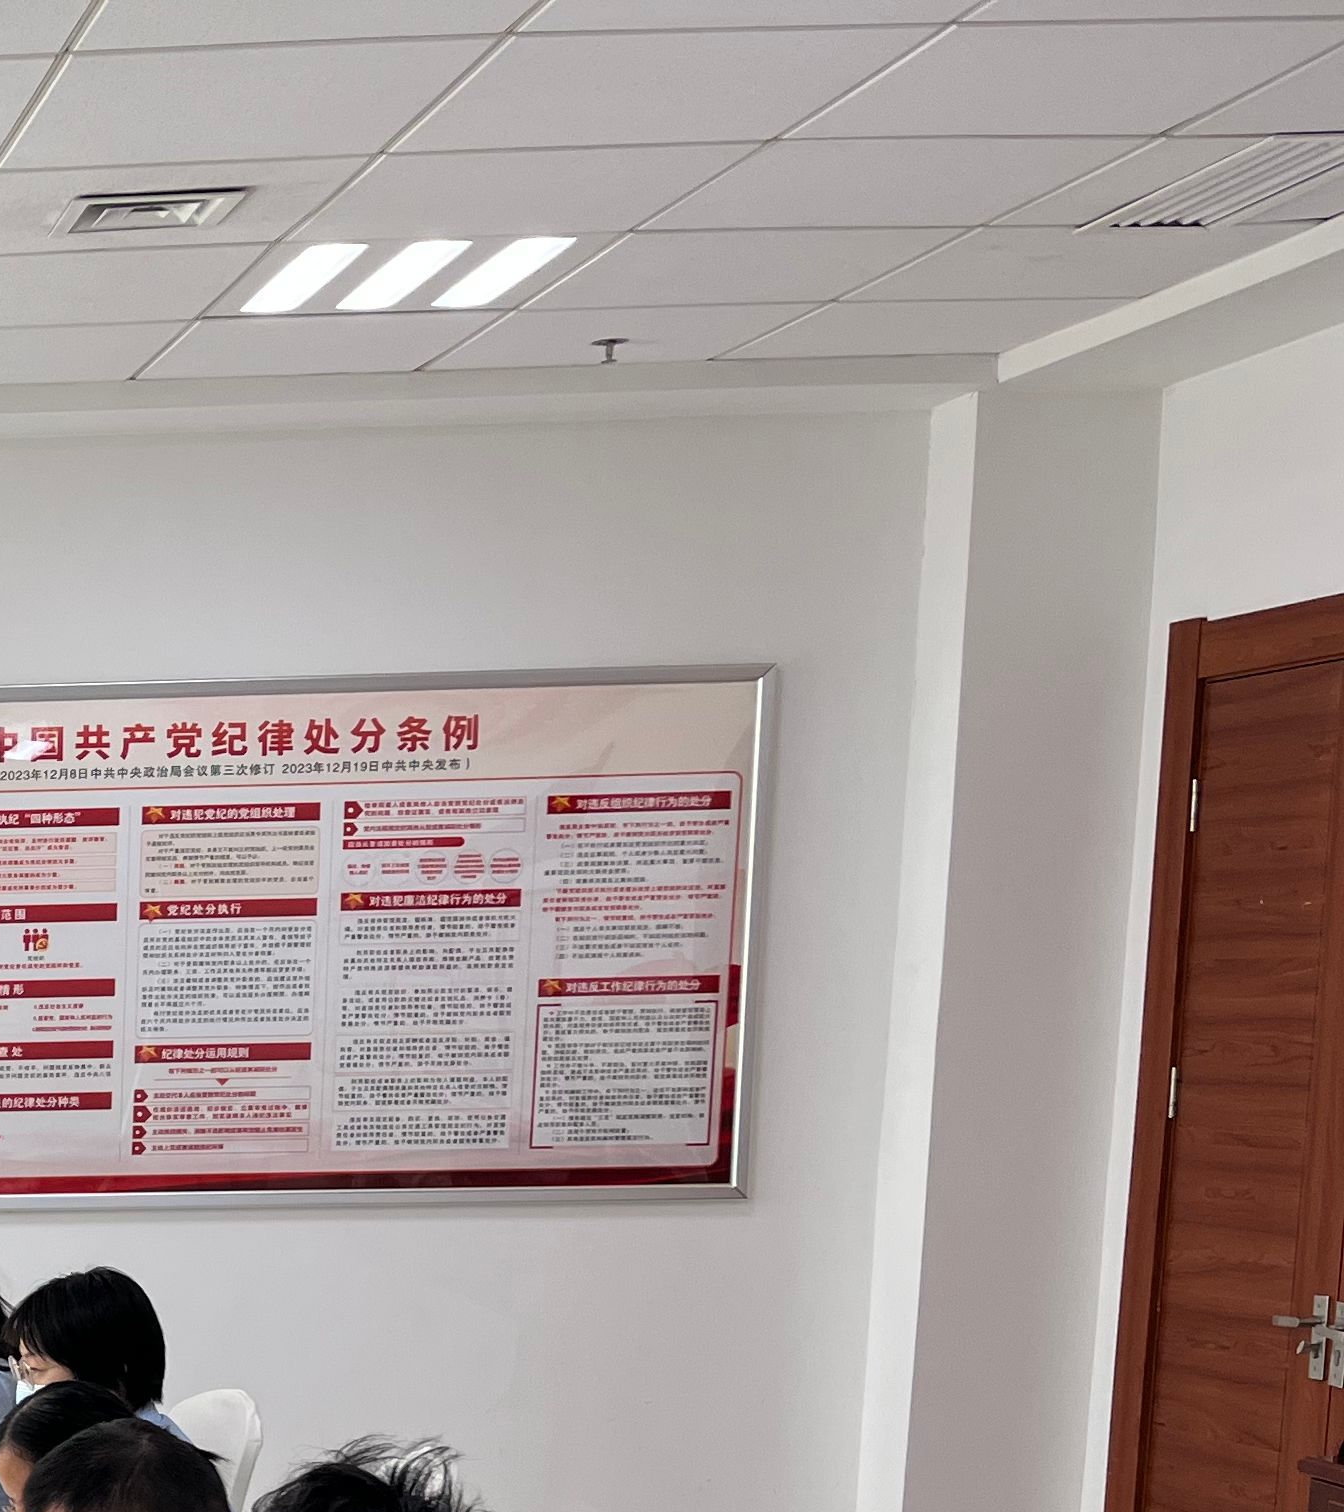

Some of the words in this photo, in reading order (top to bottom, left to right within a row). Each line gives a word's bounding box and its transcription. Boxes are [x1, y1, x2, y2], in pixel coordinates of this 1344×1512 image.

[167, 902, 242, 917] 党纪处分执行
[161, 1047, 250, 1060] 纪律处分运用规则
